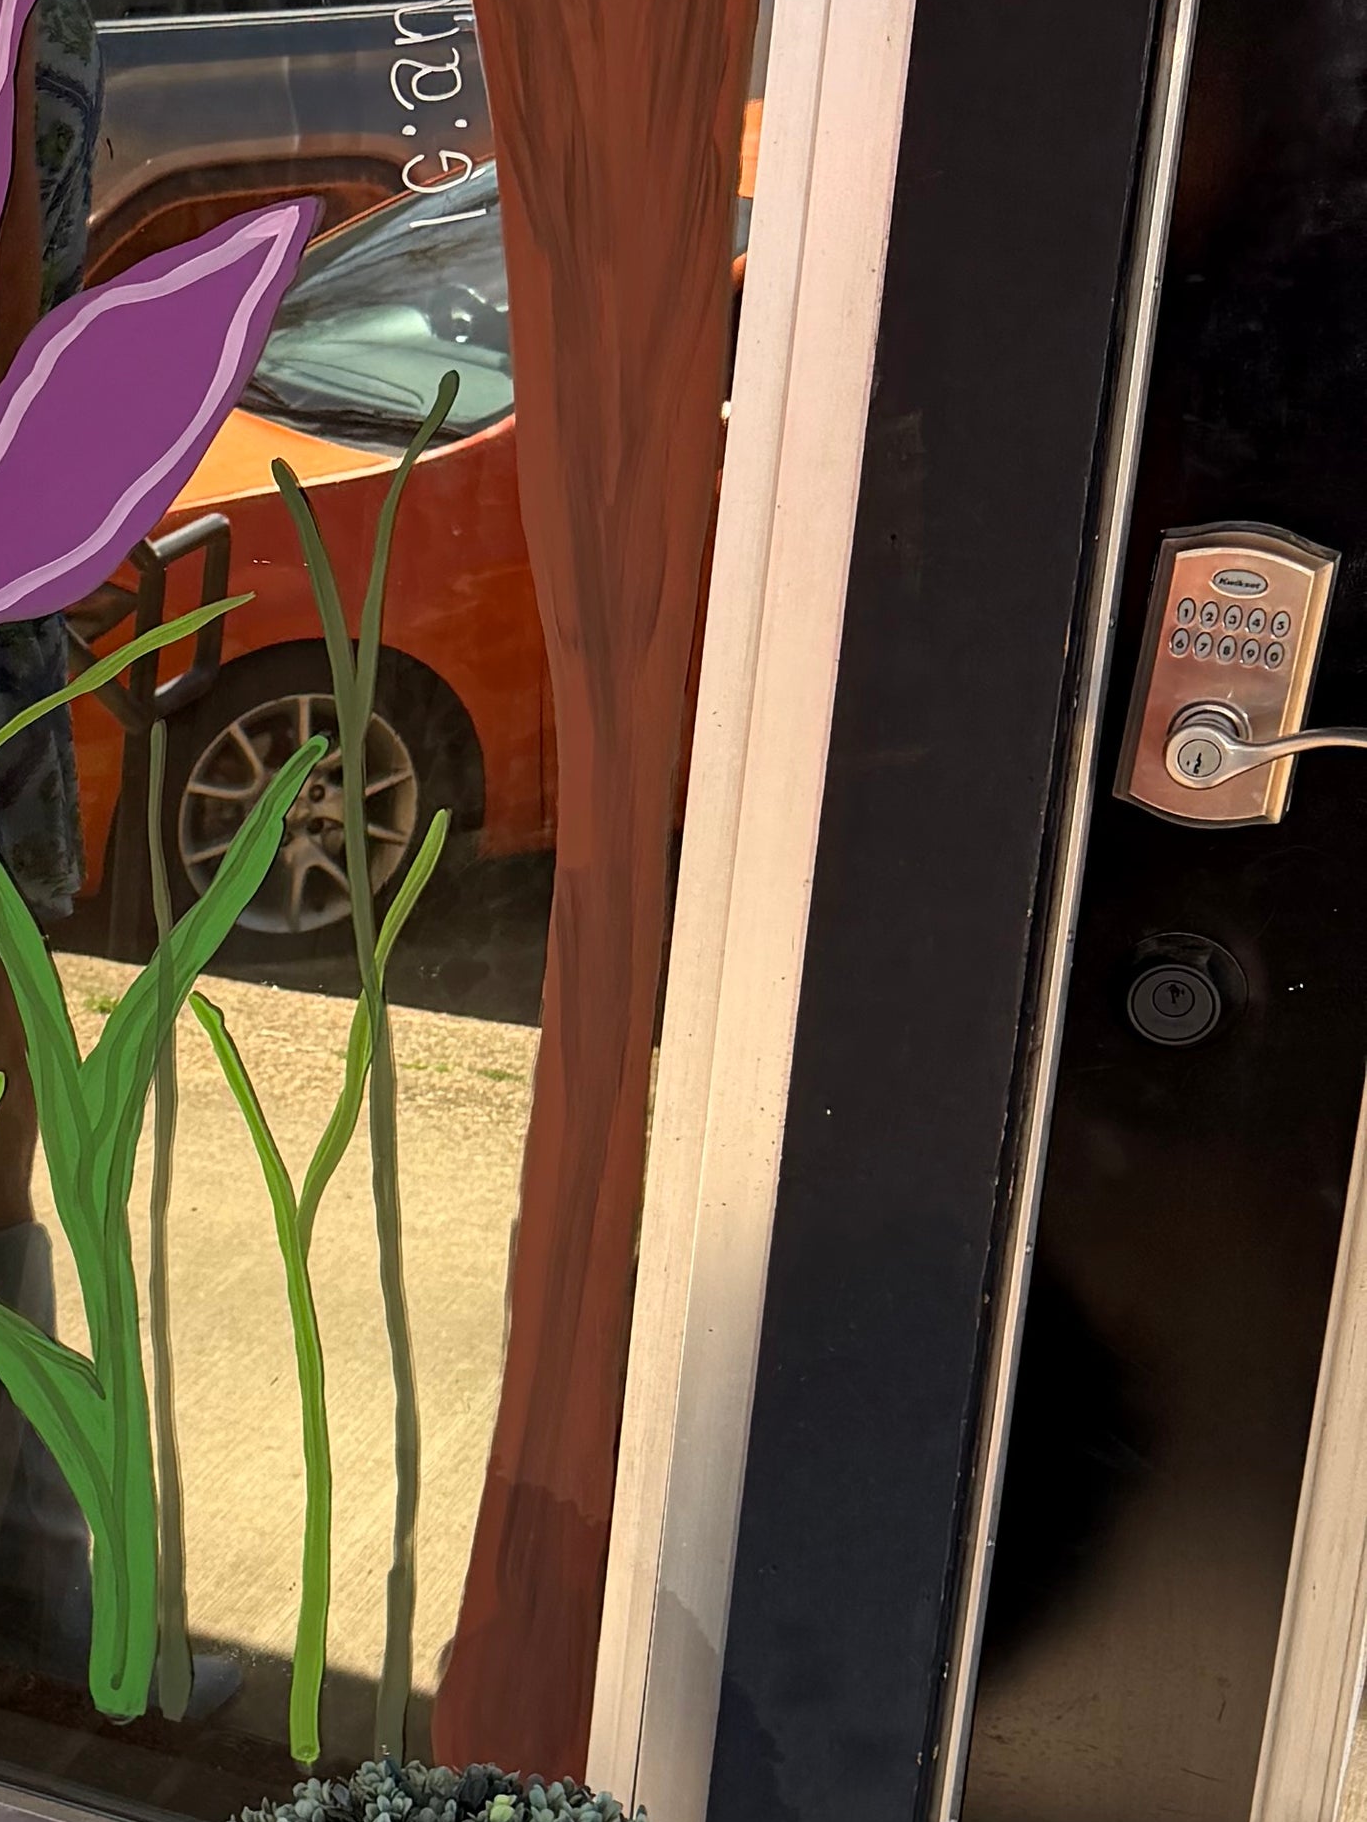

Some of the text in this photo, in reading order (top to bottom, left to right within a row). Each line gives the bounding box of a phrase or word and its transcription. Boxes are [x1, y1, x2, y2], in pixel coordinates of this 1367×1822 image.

[1205, 612, 1214, 622] 2
[1228, 615, 1237, 625] 3
[1251, 618, 1261, 628] 4
[1175, 639, 1279, 662] 6 7 8 9 0
